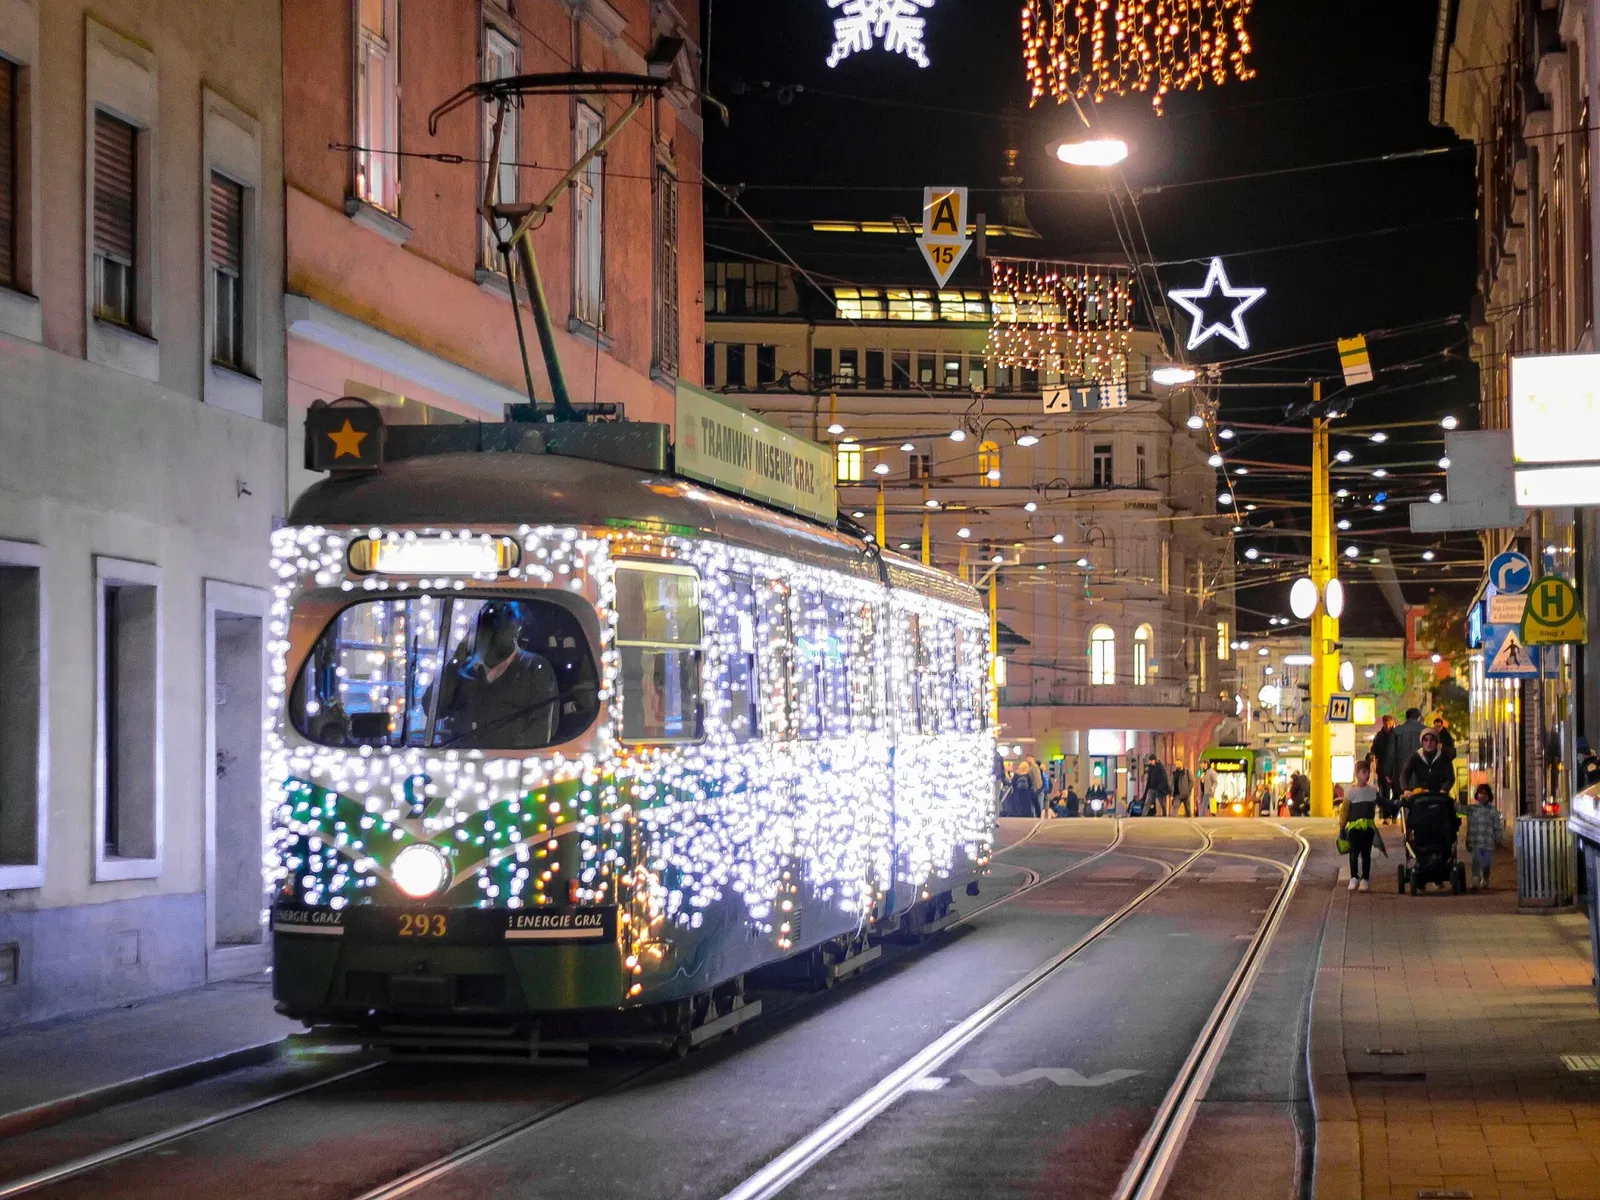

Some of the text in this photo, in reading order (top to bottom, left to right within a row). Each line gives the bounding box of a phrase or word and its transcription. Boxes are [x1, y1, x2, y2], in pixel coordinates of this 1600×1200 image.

[931, 196, 958, 232] A
[932, 246, 954, 264] 15
[1076, 387, 1091, 408] T
[701, 416, 815, 494] TRAMWAY MUSEUM GRAZ
[1540, 584, 1564, 618] H
[312, 911, 342, 924] GRAZ
[398, 914, 447, 937] 293
[516, 914, 602, 928] ENERGIE GRAZ
